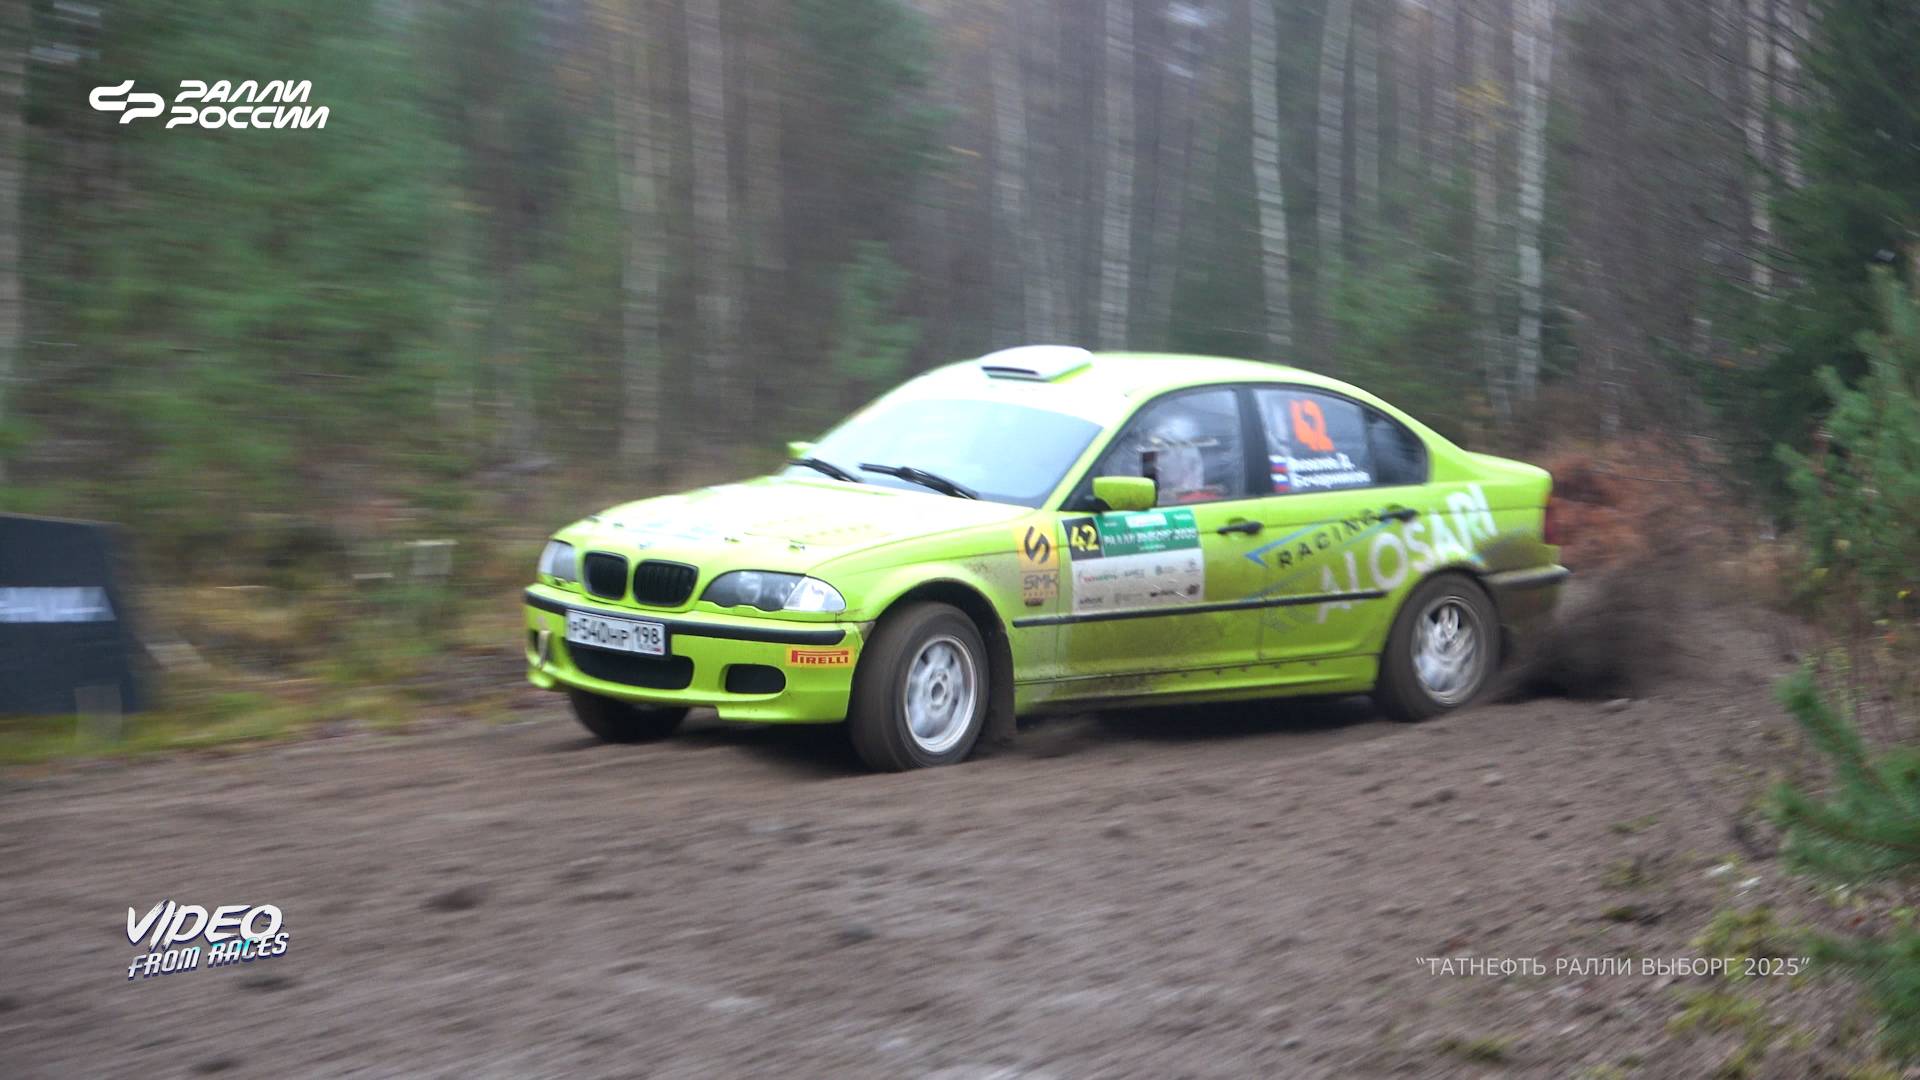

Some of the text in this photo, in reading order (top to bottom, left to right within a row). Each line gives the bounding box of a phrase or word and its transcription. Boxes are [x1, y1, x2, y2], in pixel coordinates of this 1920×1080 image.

[1070, 524, 1099, 552] 42
[1278, 509, 1377, 568] RACING
[633, 625, 660, 645] 198
[790, 649, 849, 664] PIRELLI
